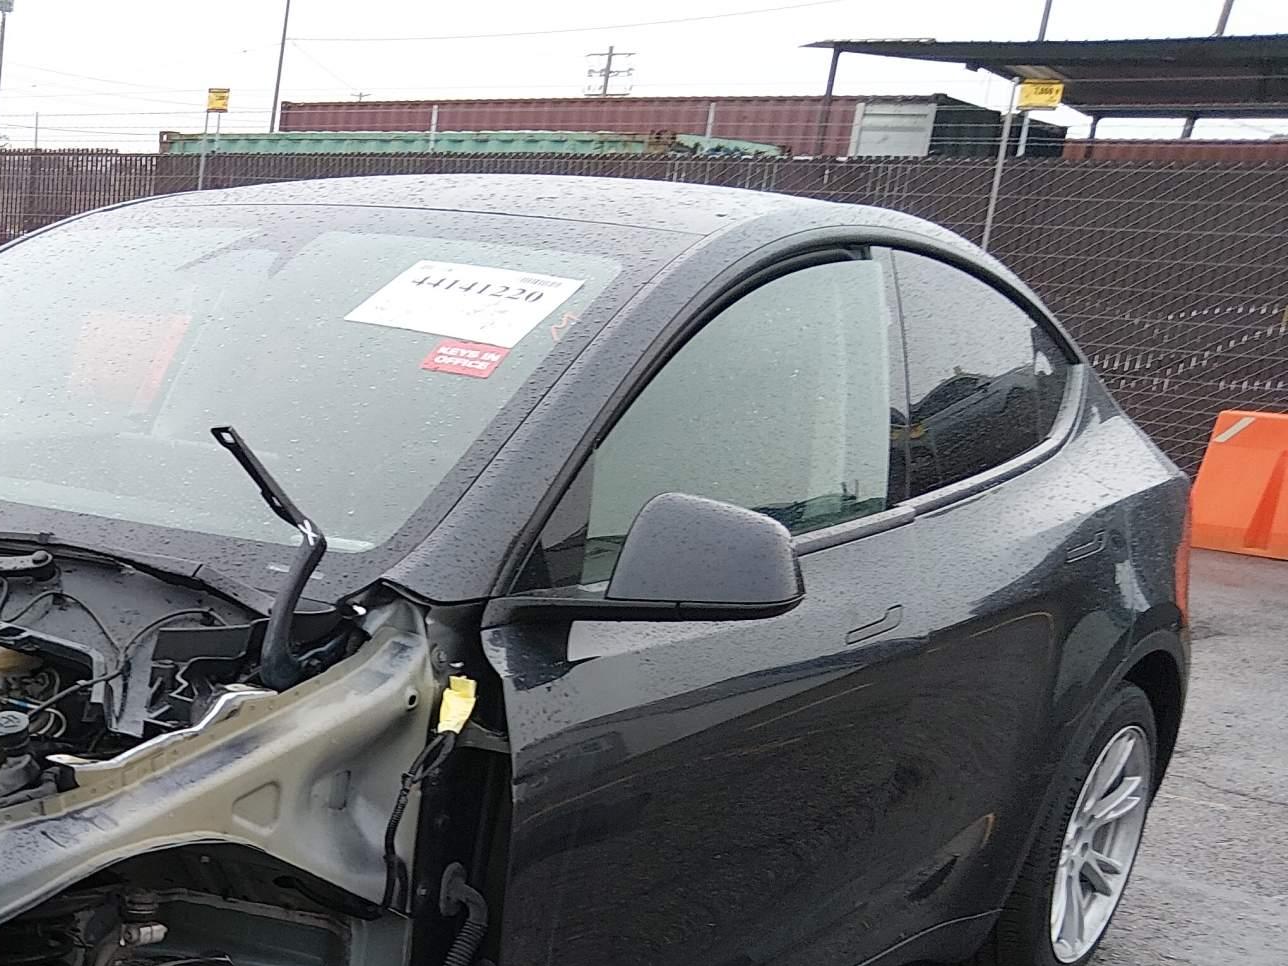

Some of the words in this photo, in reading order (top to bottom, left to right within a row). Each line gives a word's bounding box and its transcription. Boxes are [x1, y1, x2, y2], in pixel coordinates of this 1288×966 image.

[411, 275, 544, 302] 44141220
[437, 346, 480, 359] KEYS
[480, 352, 501, 361] IN
[434, 355, 490, 370] OFFICE
